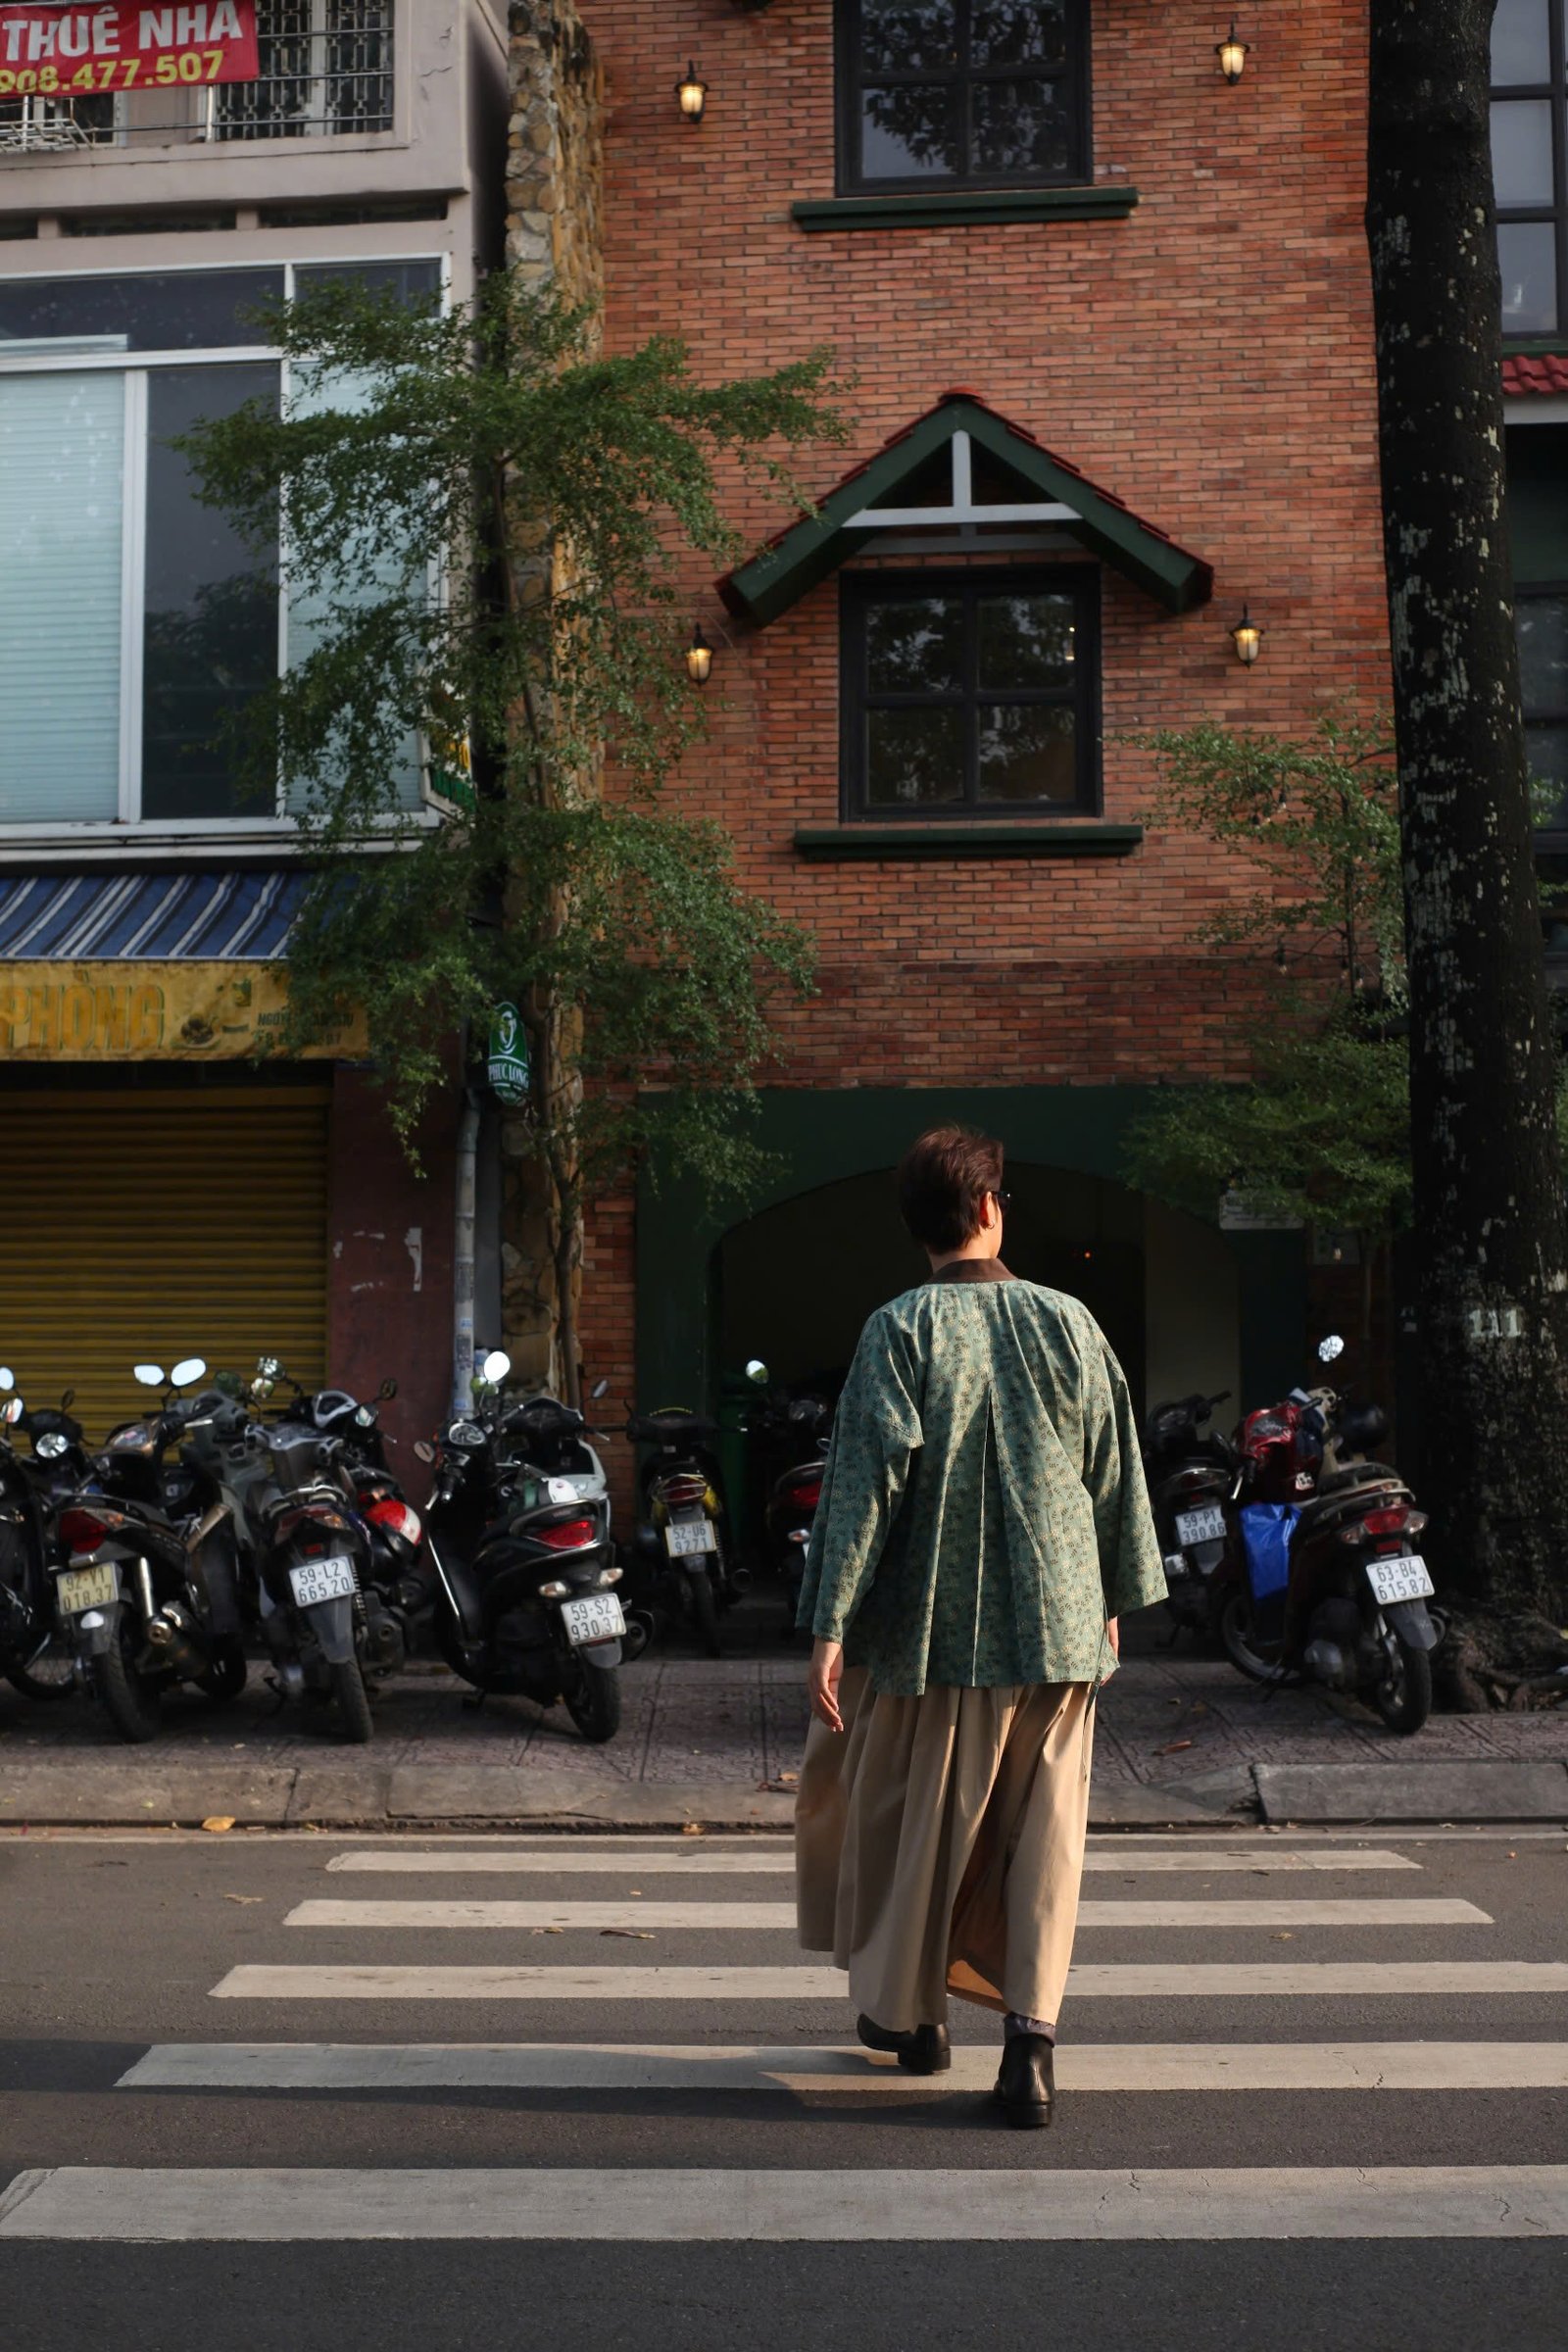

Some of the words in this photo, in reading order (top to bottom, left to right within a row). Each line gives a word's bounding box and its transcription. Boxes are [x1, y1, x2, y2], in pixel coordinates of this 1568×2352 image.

[2, 6, 120, 62] THUÊ
[509, 1064, 529, 1090] LONG
[674, 1538, 708, 1553] 9271
[1378, 1577, 1430, 1600] 615.82
